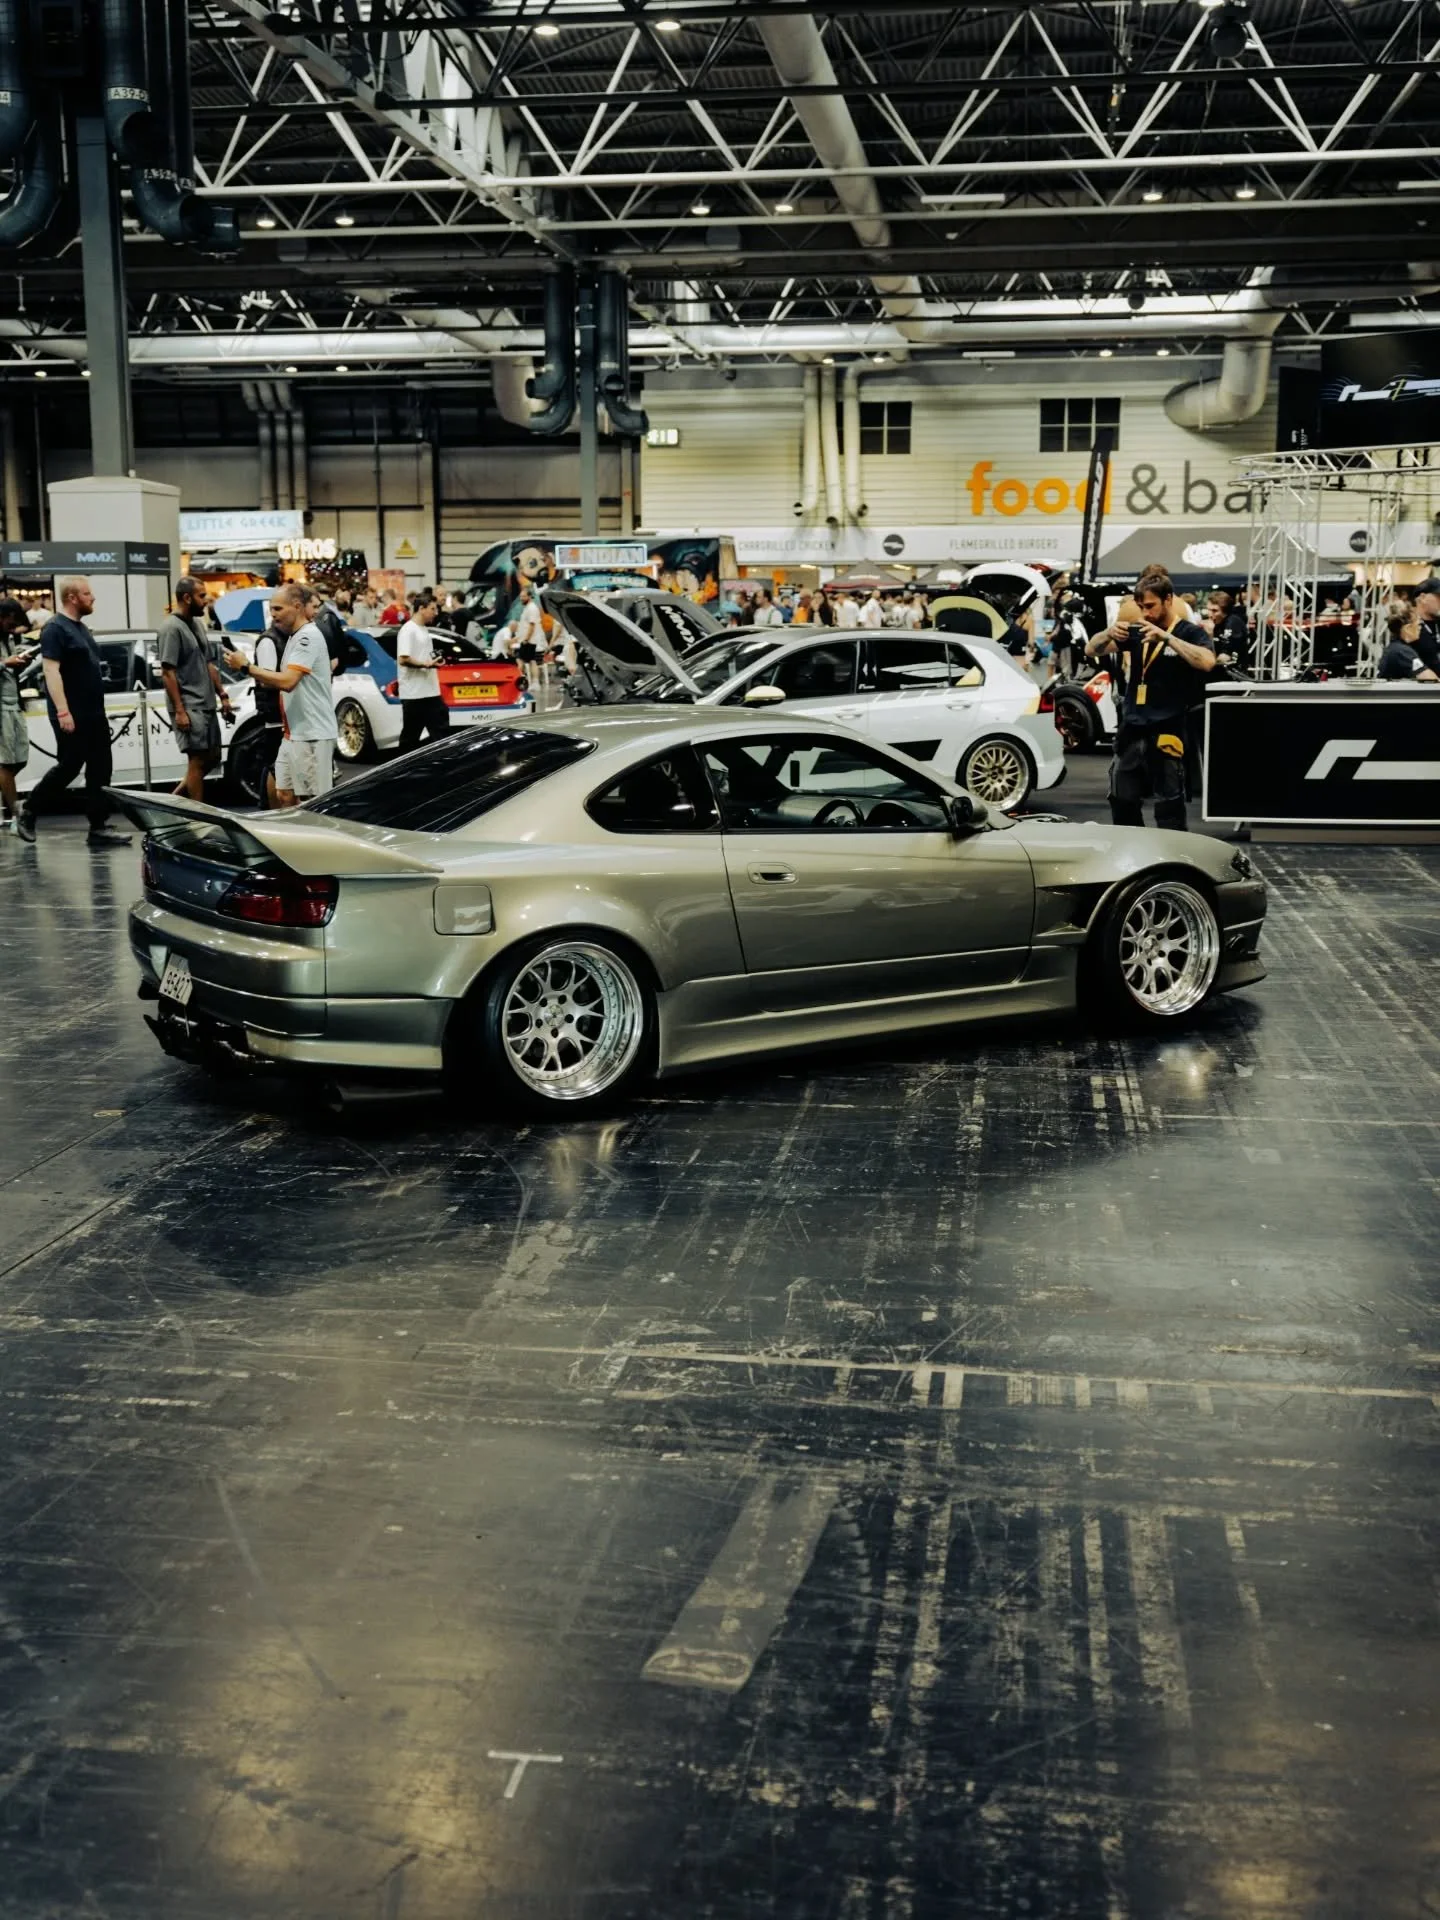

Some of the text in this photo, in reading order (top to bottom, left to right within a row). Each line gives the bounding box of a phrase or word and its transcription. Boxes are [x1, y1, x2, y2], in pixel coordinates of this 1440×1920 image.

[1126, 463, 1171, 515] &
[187, 516, 287, 530] LITTLE GREEK
[278, 538, 337, 560] GYROS
